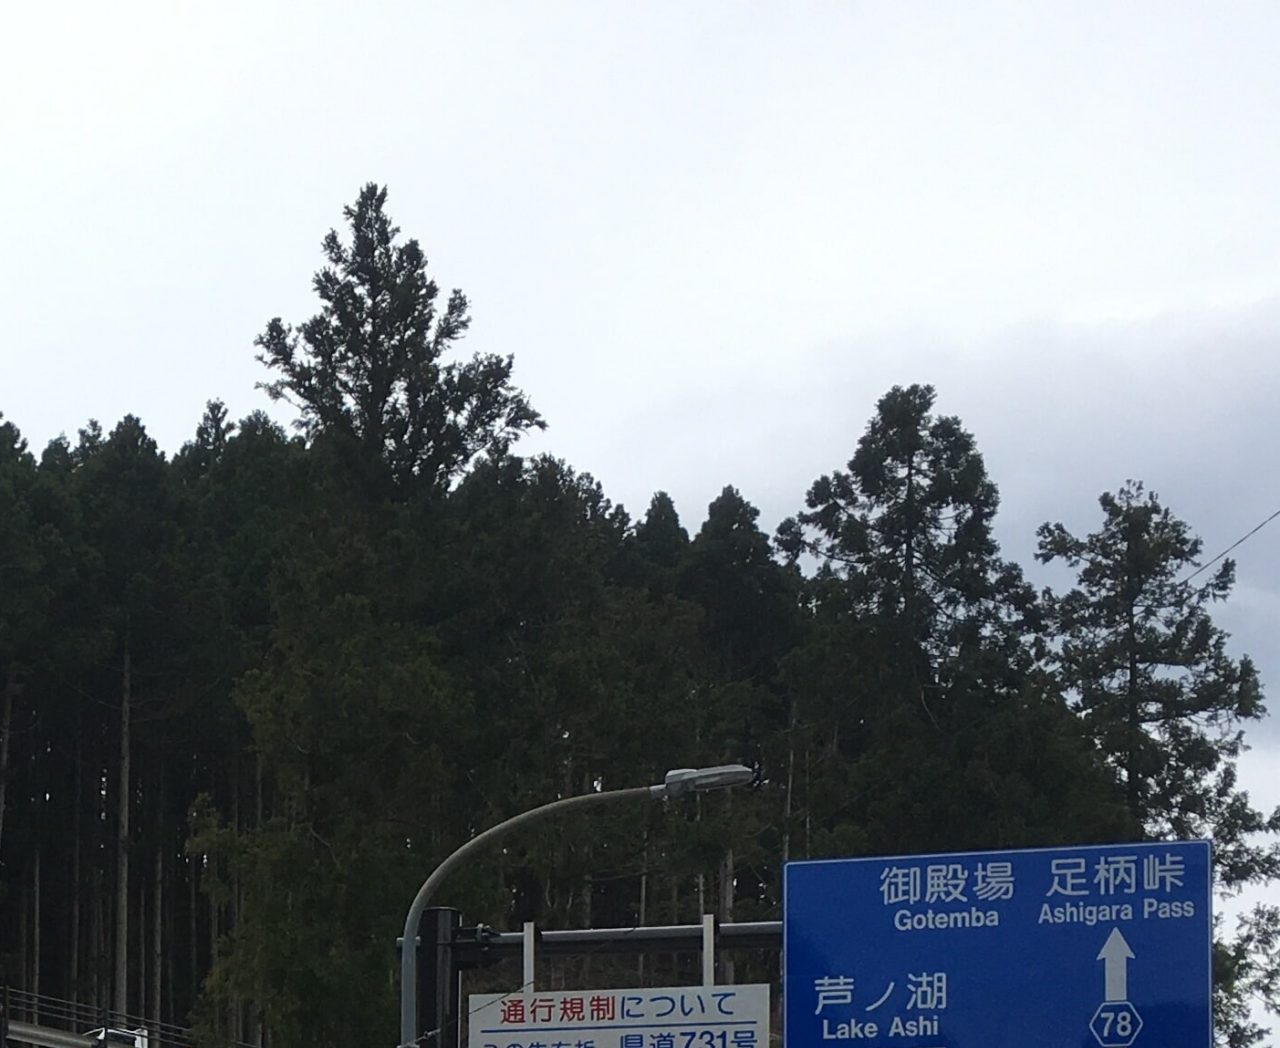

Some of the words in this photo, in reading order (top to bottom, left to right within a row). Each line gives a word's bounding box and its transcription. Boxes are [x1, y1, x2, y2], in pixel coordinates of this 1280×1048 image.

[879, 861, 1016, 905] 御殿場
[1046, 853, 1185, 897] 足柄峠
[894, 908, 999, 931] Gotemba
[1038, 902, 1133, 927] Ashigara
[1143, 898, 1195, 919] Pass
[500, 992, 737, 1024] 通行規制について
[814, 972, 947, 1015] 芦ノ湖
[822, 1019, 879, 1039] Lake
[888, 1016, 939, 1037] Ashi
[1099, 1012, 1132, 1037] 78
